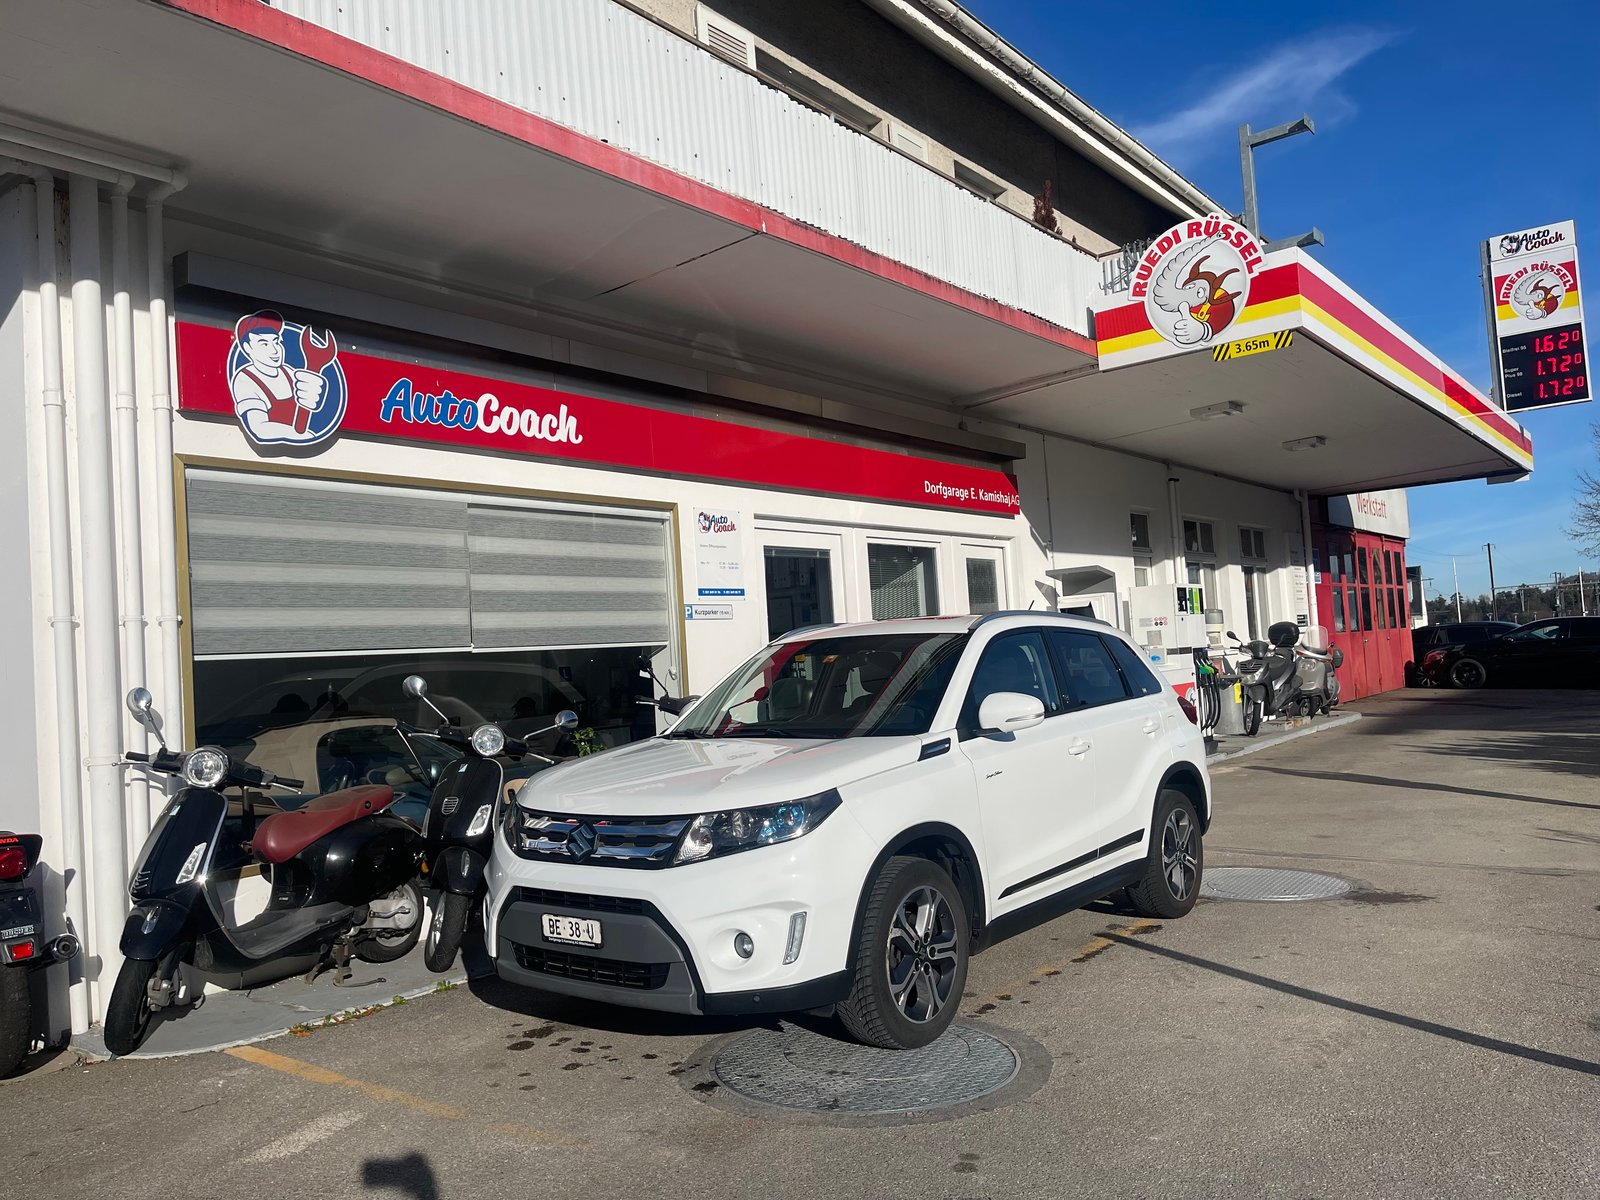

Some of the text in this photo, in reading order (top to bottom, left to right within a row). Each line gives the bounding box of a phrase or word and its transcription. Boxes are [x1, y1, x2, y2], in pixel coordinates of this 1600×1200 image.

[1520, 229, 1550, 245] Auto
[1525, 231, 1566, 251] Coach
[1132, 215, 1263, 297] RUEDI RÜSSEL
[1502, 260, 1574, 299] RUEDI RÜSSEL
[1235, 339, 1270, 353] 3.65m
[924, 480, 969, 501] Dorfgarage
[970, 487, 978, 500] E.
[979, 488, 1011, 507] Kamishaj
[1355, 492, 1387, 519] Werkstatt
[709, 514, 728, 525] Auto
[713, 520, 736, 533] Coach
